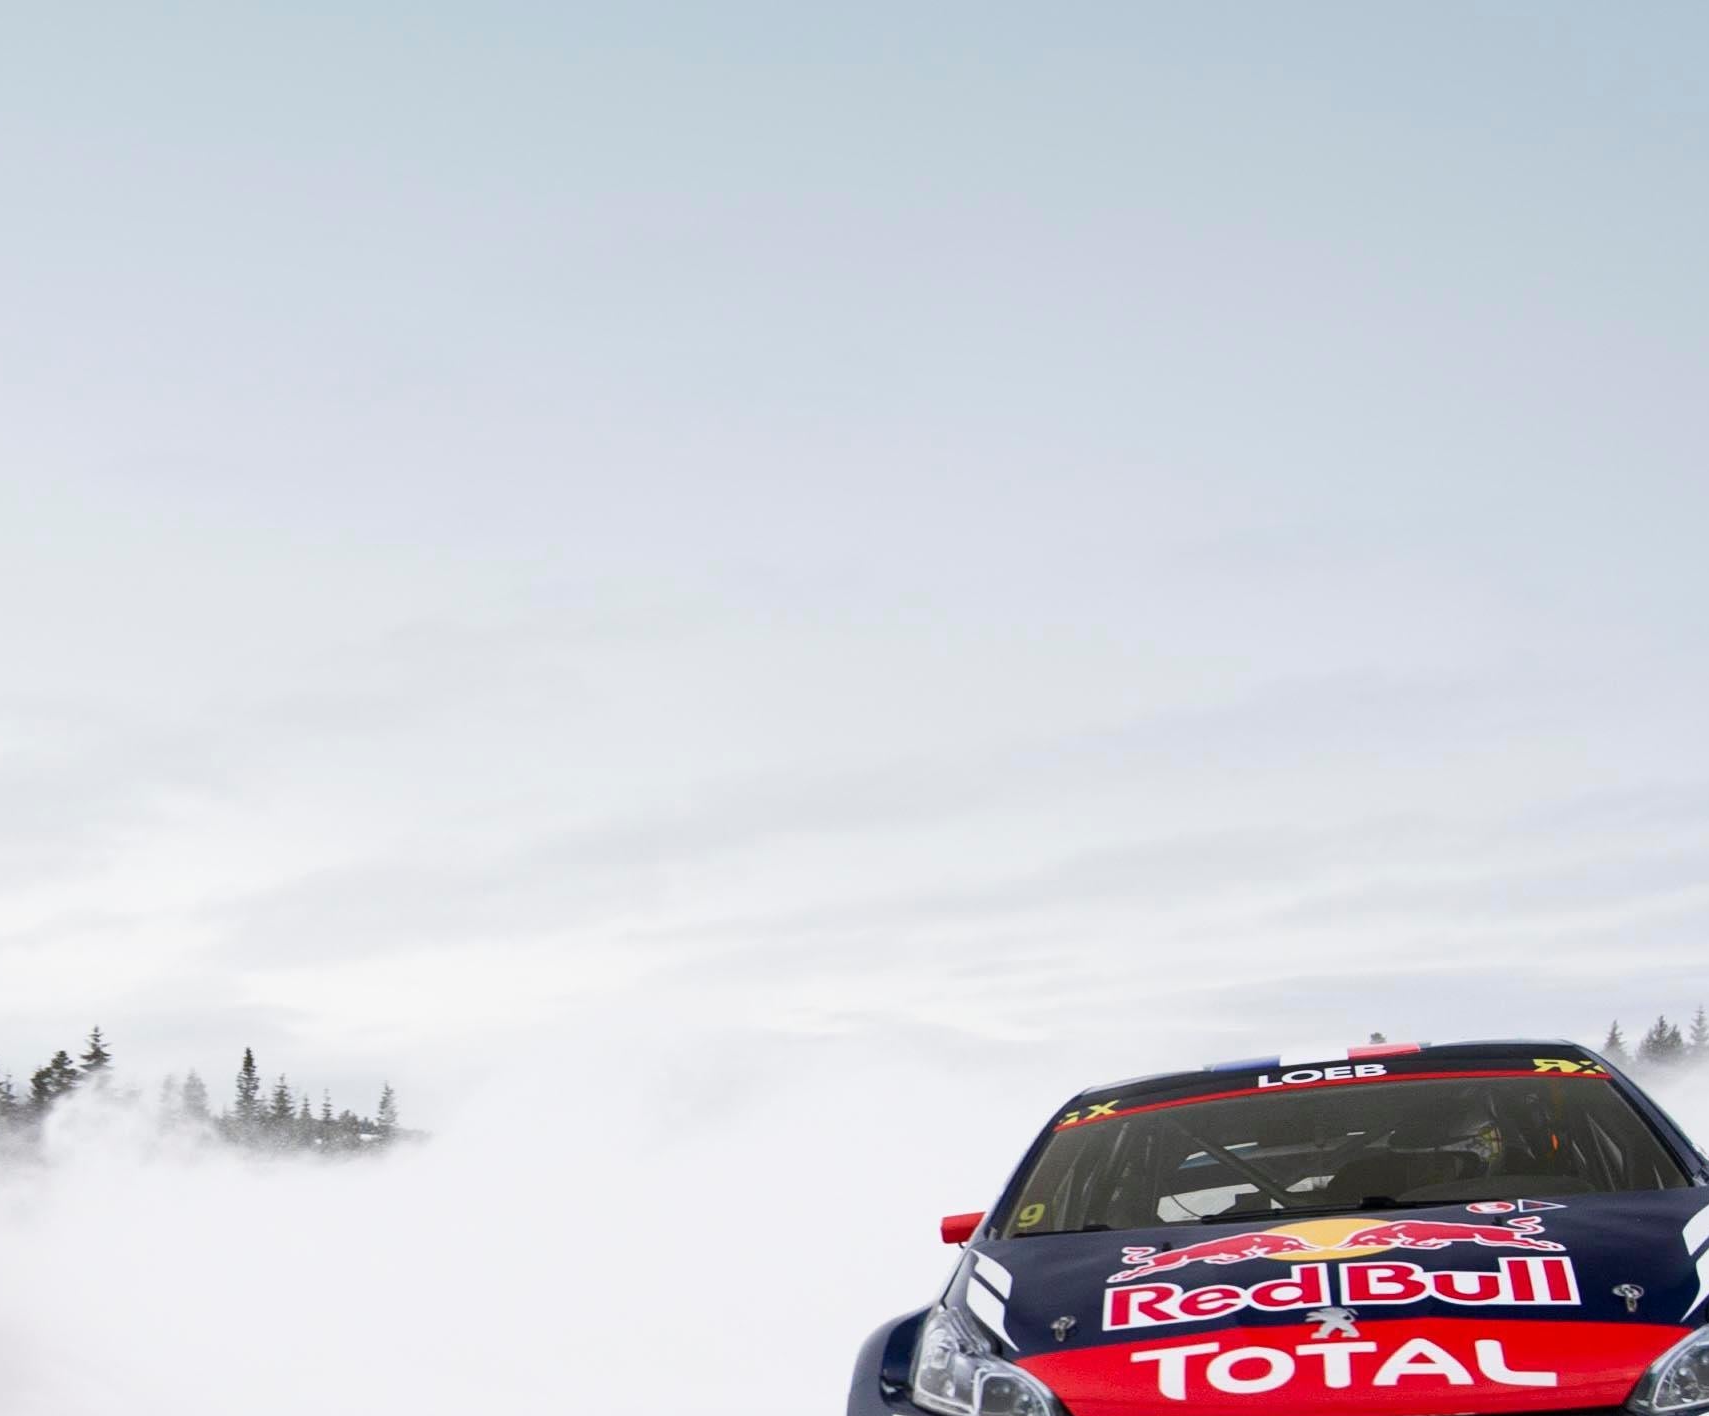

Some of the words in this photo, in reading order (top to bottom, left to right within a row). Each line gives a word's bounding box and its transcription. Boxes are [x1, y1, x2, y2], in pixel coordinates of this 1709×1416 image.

[1258, 1063, 1388, 1088] LOEB
[1018, 1203, 1045, 1228] 9
[1102, 1263, 1331, 1331] Red
[1339, 1256, 1581, 1305] Bull
[1130, 1337, 1558, 1401] TOTAL
